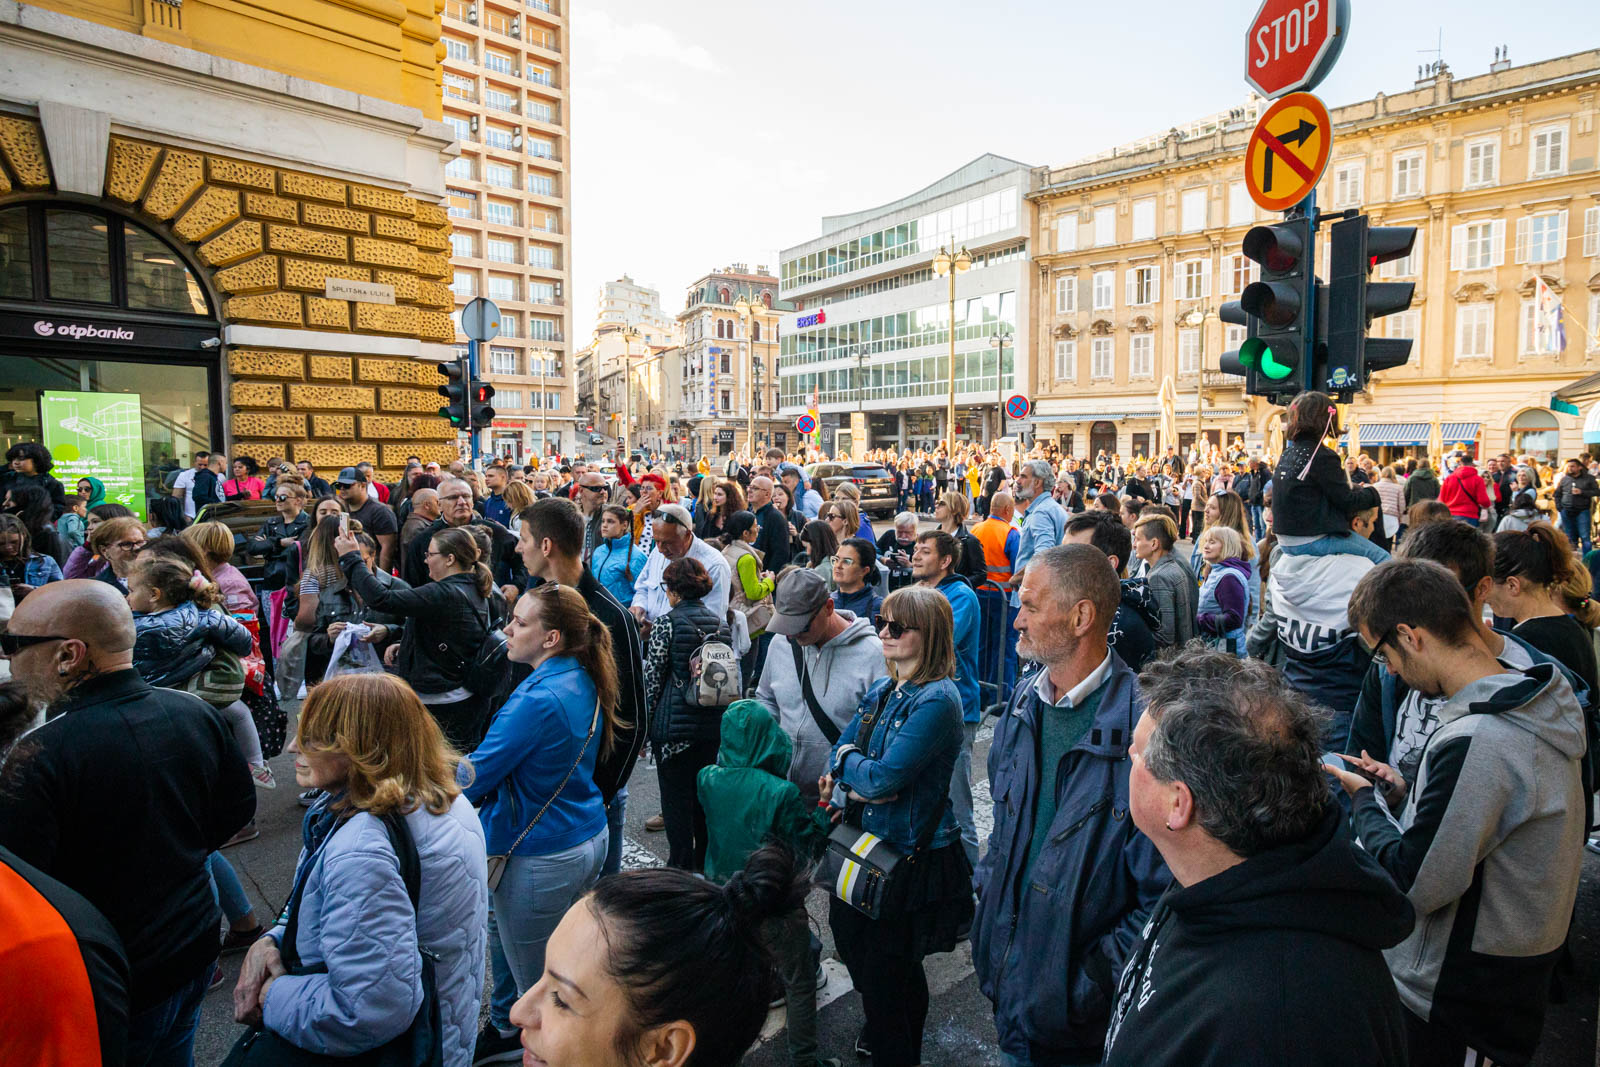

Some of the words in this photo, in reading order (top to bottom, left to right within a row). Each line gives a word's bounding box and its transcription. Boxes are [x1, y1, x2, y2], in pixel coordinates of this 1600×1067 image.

[1256, 0, 1319, 68] STOP
[331, 286, 367, 295] SPLITSKA
[797, 314, 818, 328] ERSTE
[57, 324, 134, 340] otpbanka
